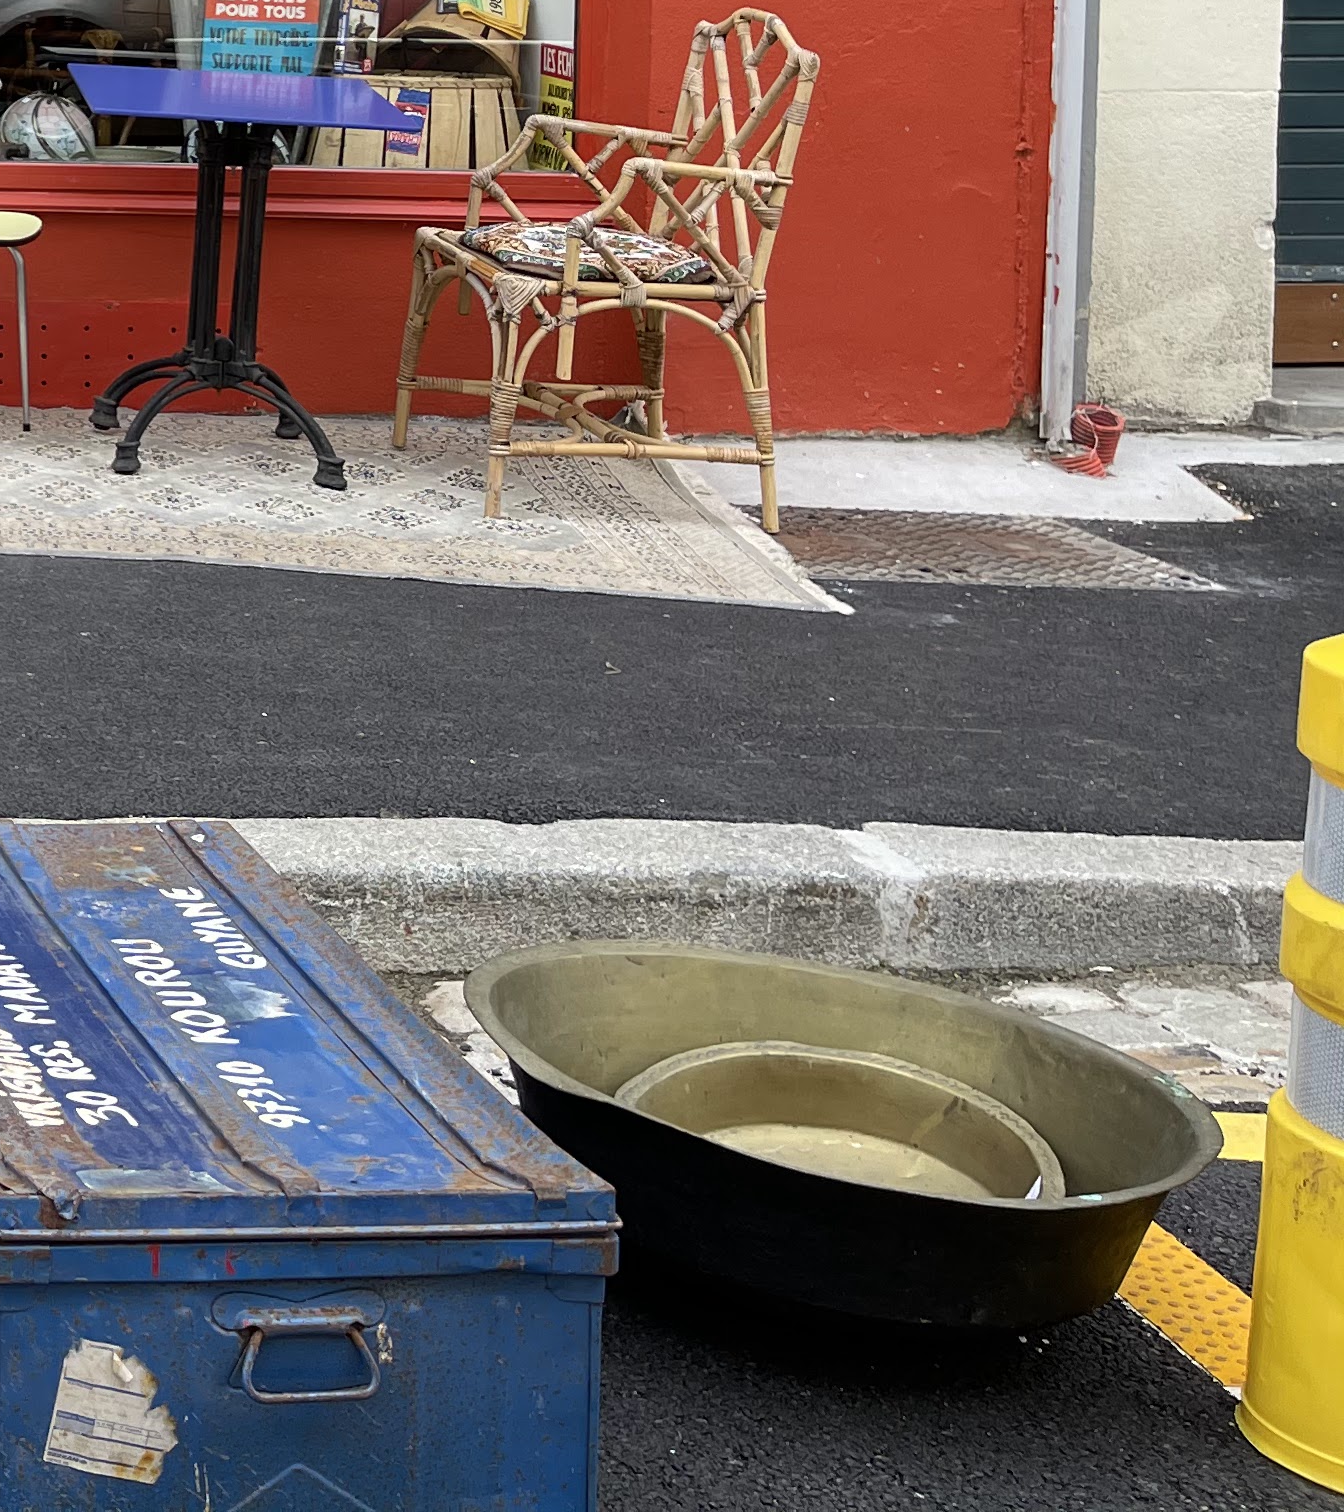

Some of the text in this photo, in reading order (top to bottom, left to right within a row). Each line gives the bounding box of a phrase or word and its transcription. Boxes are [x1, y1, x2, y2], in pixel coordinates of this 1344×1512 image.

[215, 2, 307, 20] POUR TOUS
[543, 46, 557, 73] LES
[158, 886, 268, 970] GUYANE
[110, 938, 311, 1129] 97310 KOUROU
[30, 1040, 97, 1081] RES.
[65, 1090, 139, 1127] 30
